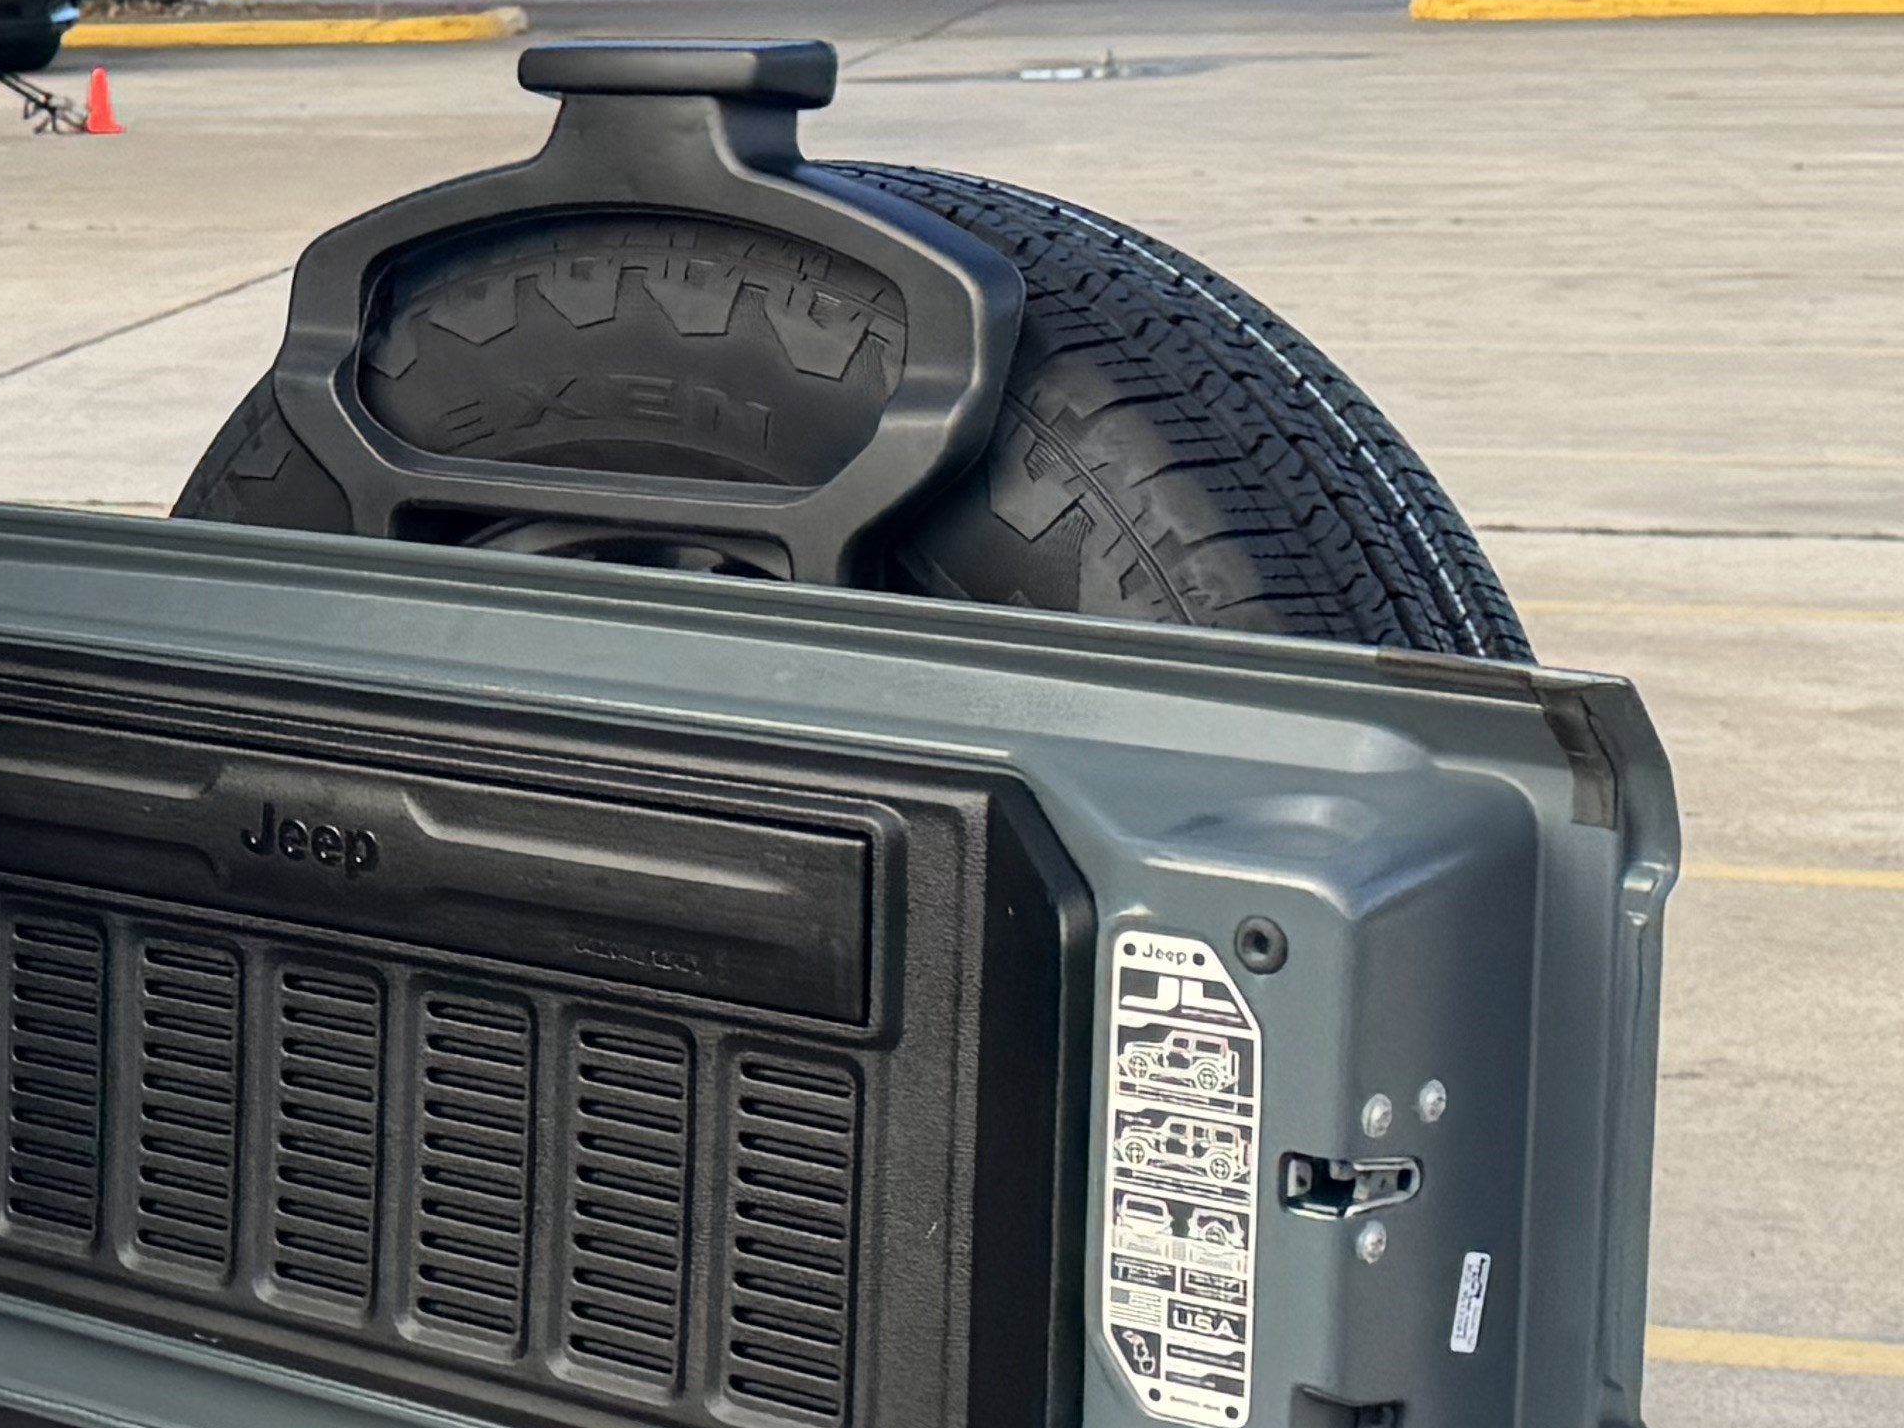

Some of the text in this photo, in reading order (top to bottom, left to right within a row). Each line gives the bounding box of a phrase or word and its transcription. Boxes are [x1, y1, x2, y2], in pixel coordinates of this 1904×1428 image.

[241, 801, 381, 880] Jeep
[1142, 943, 1188, 966] Jeep
[1173, 1309, 1239, 1340] USA
